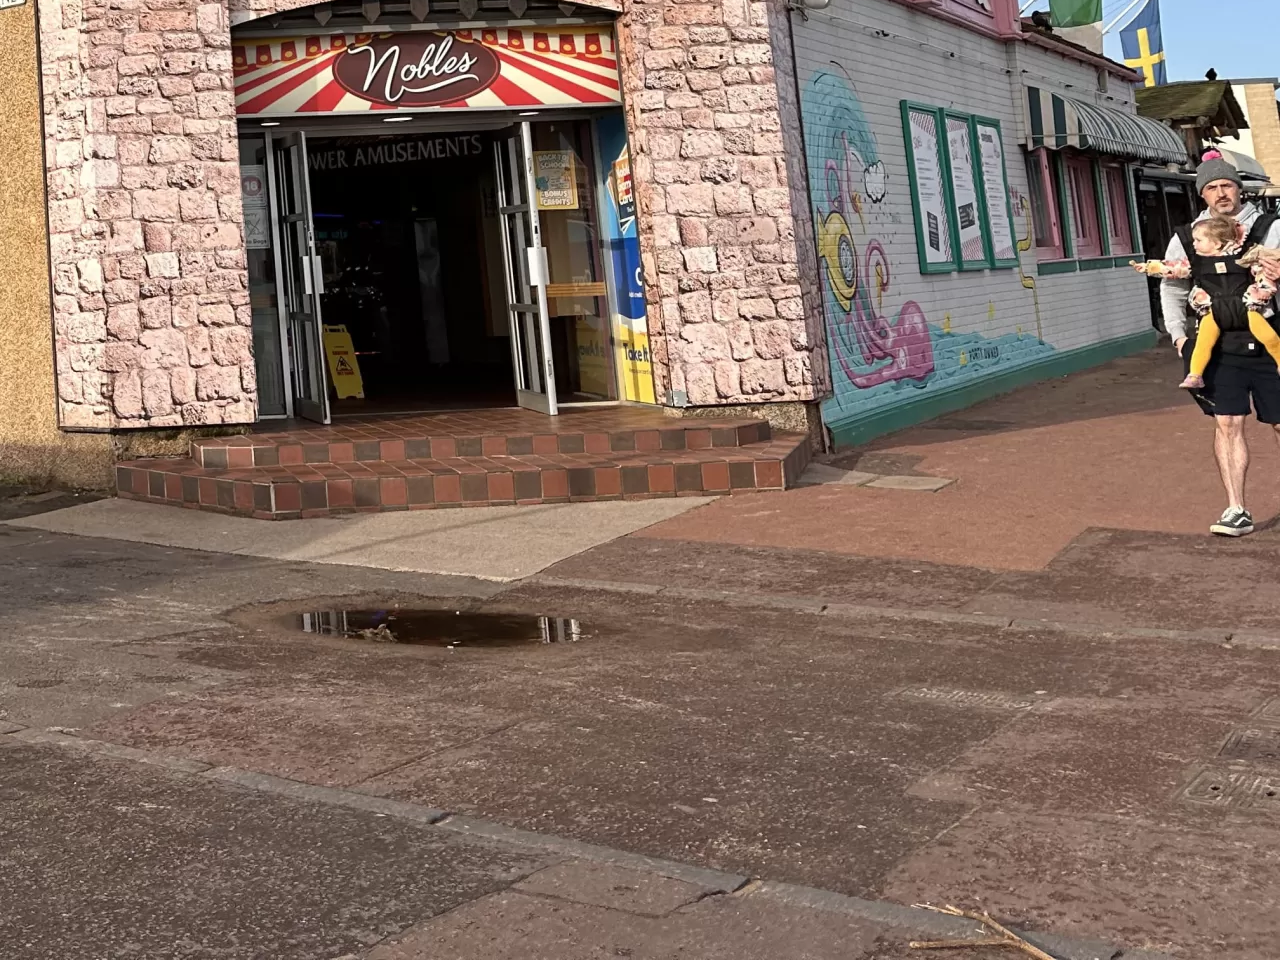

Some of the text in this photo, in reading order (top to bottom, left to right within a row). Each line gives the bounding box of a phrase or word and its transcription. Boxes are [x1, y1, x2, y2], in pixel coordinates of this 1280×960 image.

[347, 36, 479, 102] Nobles
[354, 134, 482, 166] AMUSEMENTS
[623, 343, 642, 362] Take
